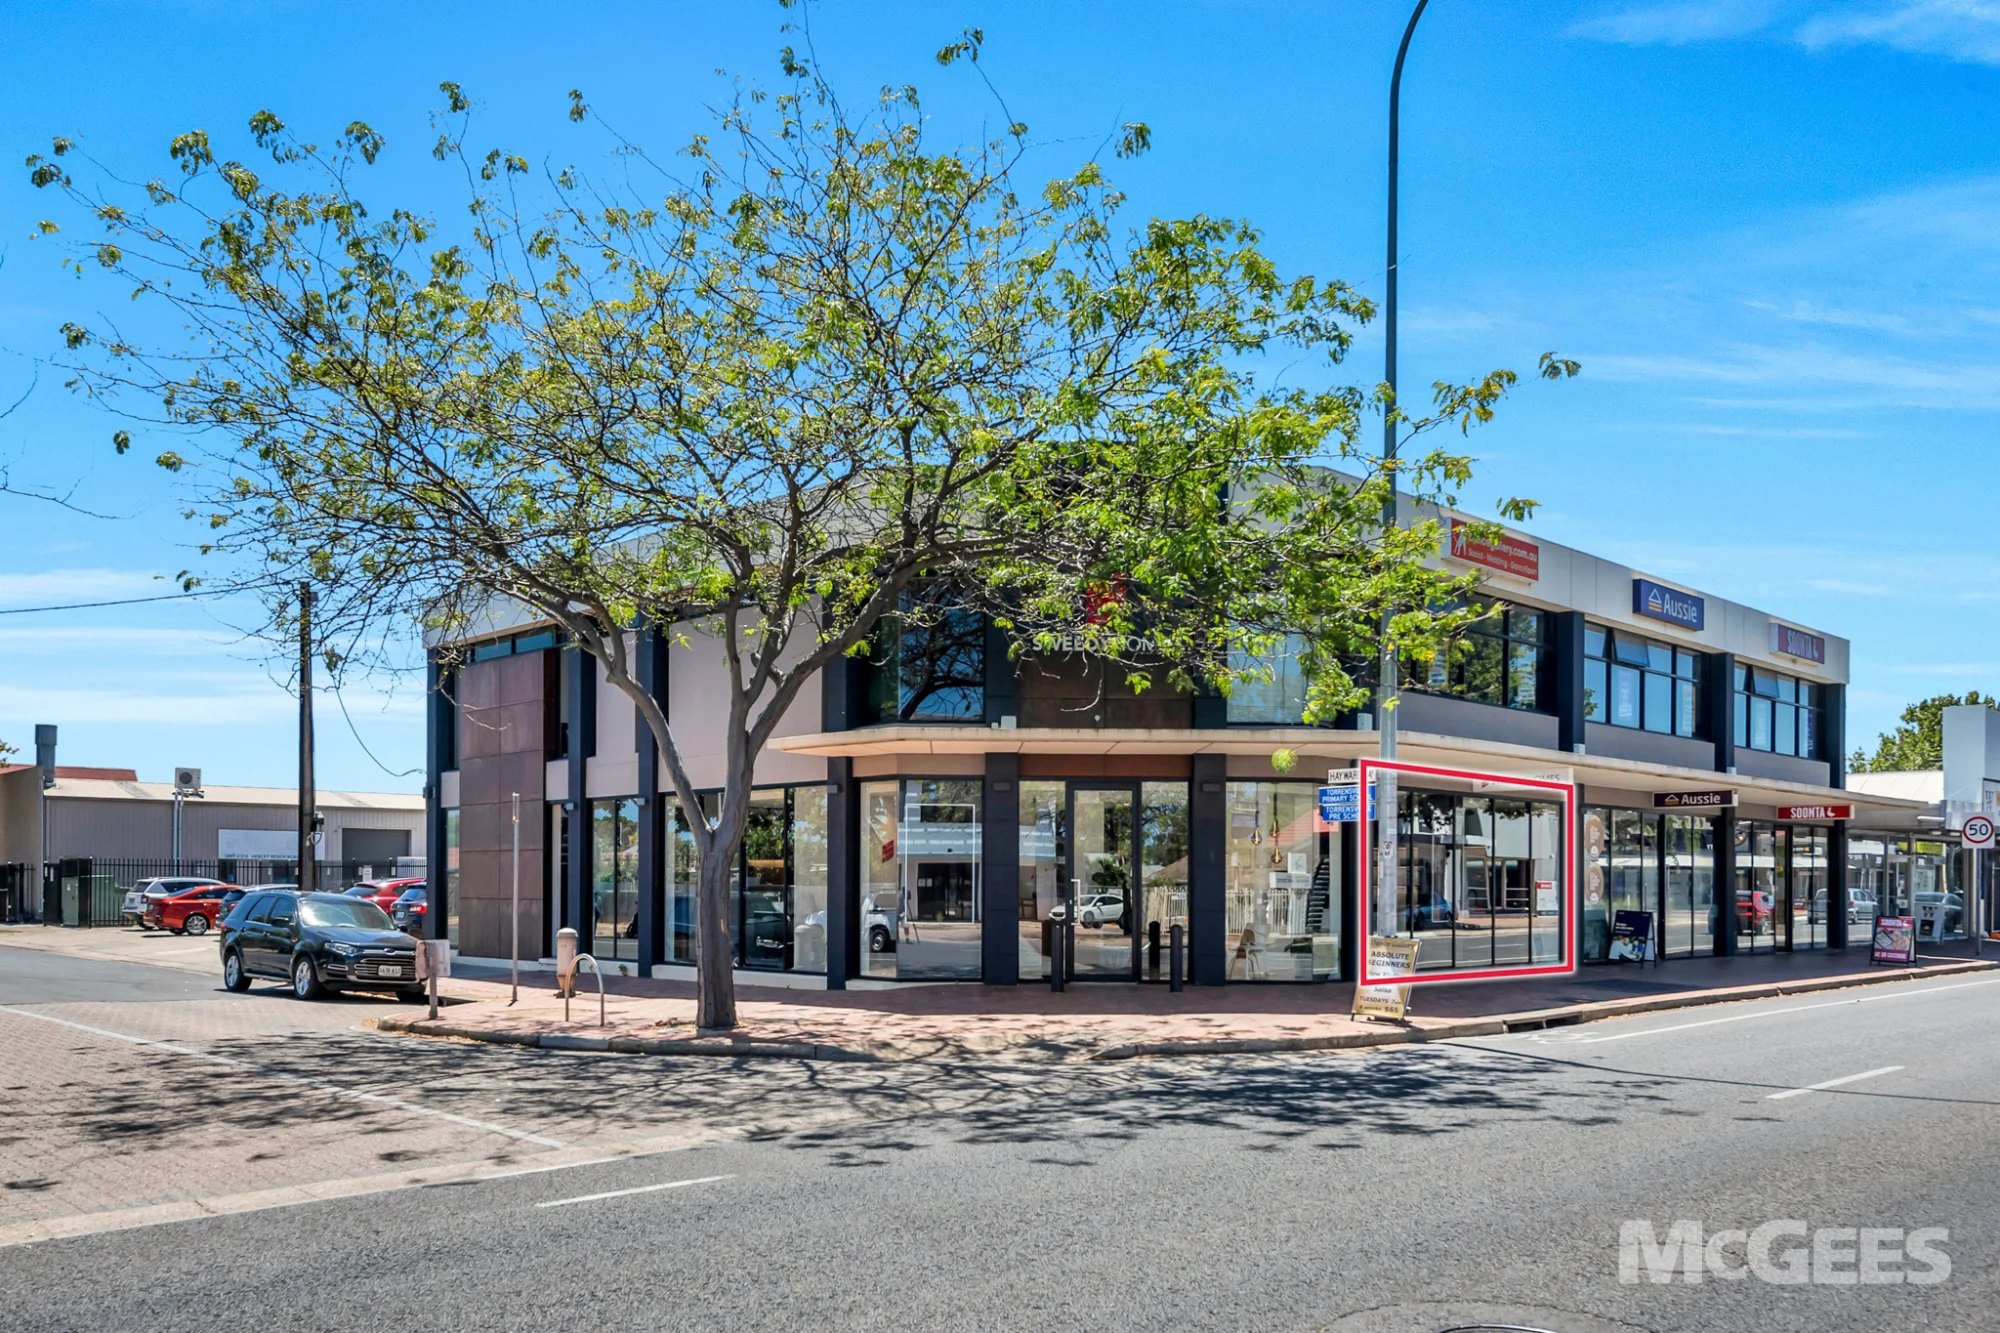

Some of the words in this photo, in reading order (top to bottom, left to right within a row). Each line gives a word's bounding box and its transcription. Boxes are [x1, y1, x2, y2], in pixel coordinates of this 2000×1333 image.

[1664, 593, 1697, 623] Aussie
[1787, 629, 1812, 659] SOONTA
[1330, 770, 1360, 781] HAYWAR
[1322, 795, 1348, 803] PRIMARY
[1681, 793, 1721, 805] Aussie
[1790, 806, 1825, 819] SOONTA
[1968, 823, 1989, 836] 50
[1371, 951, 1410, 960] ABSOLUTE
[1360, 995, 1389, 1003] TUESDAYS
